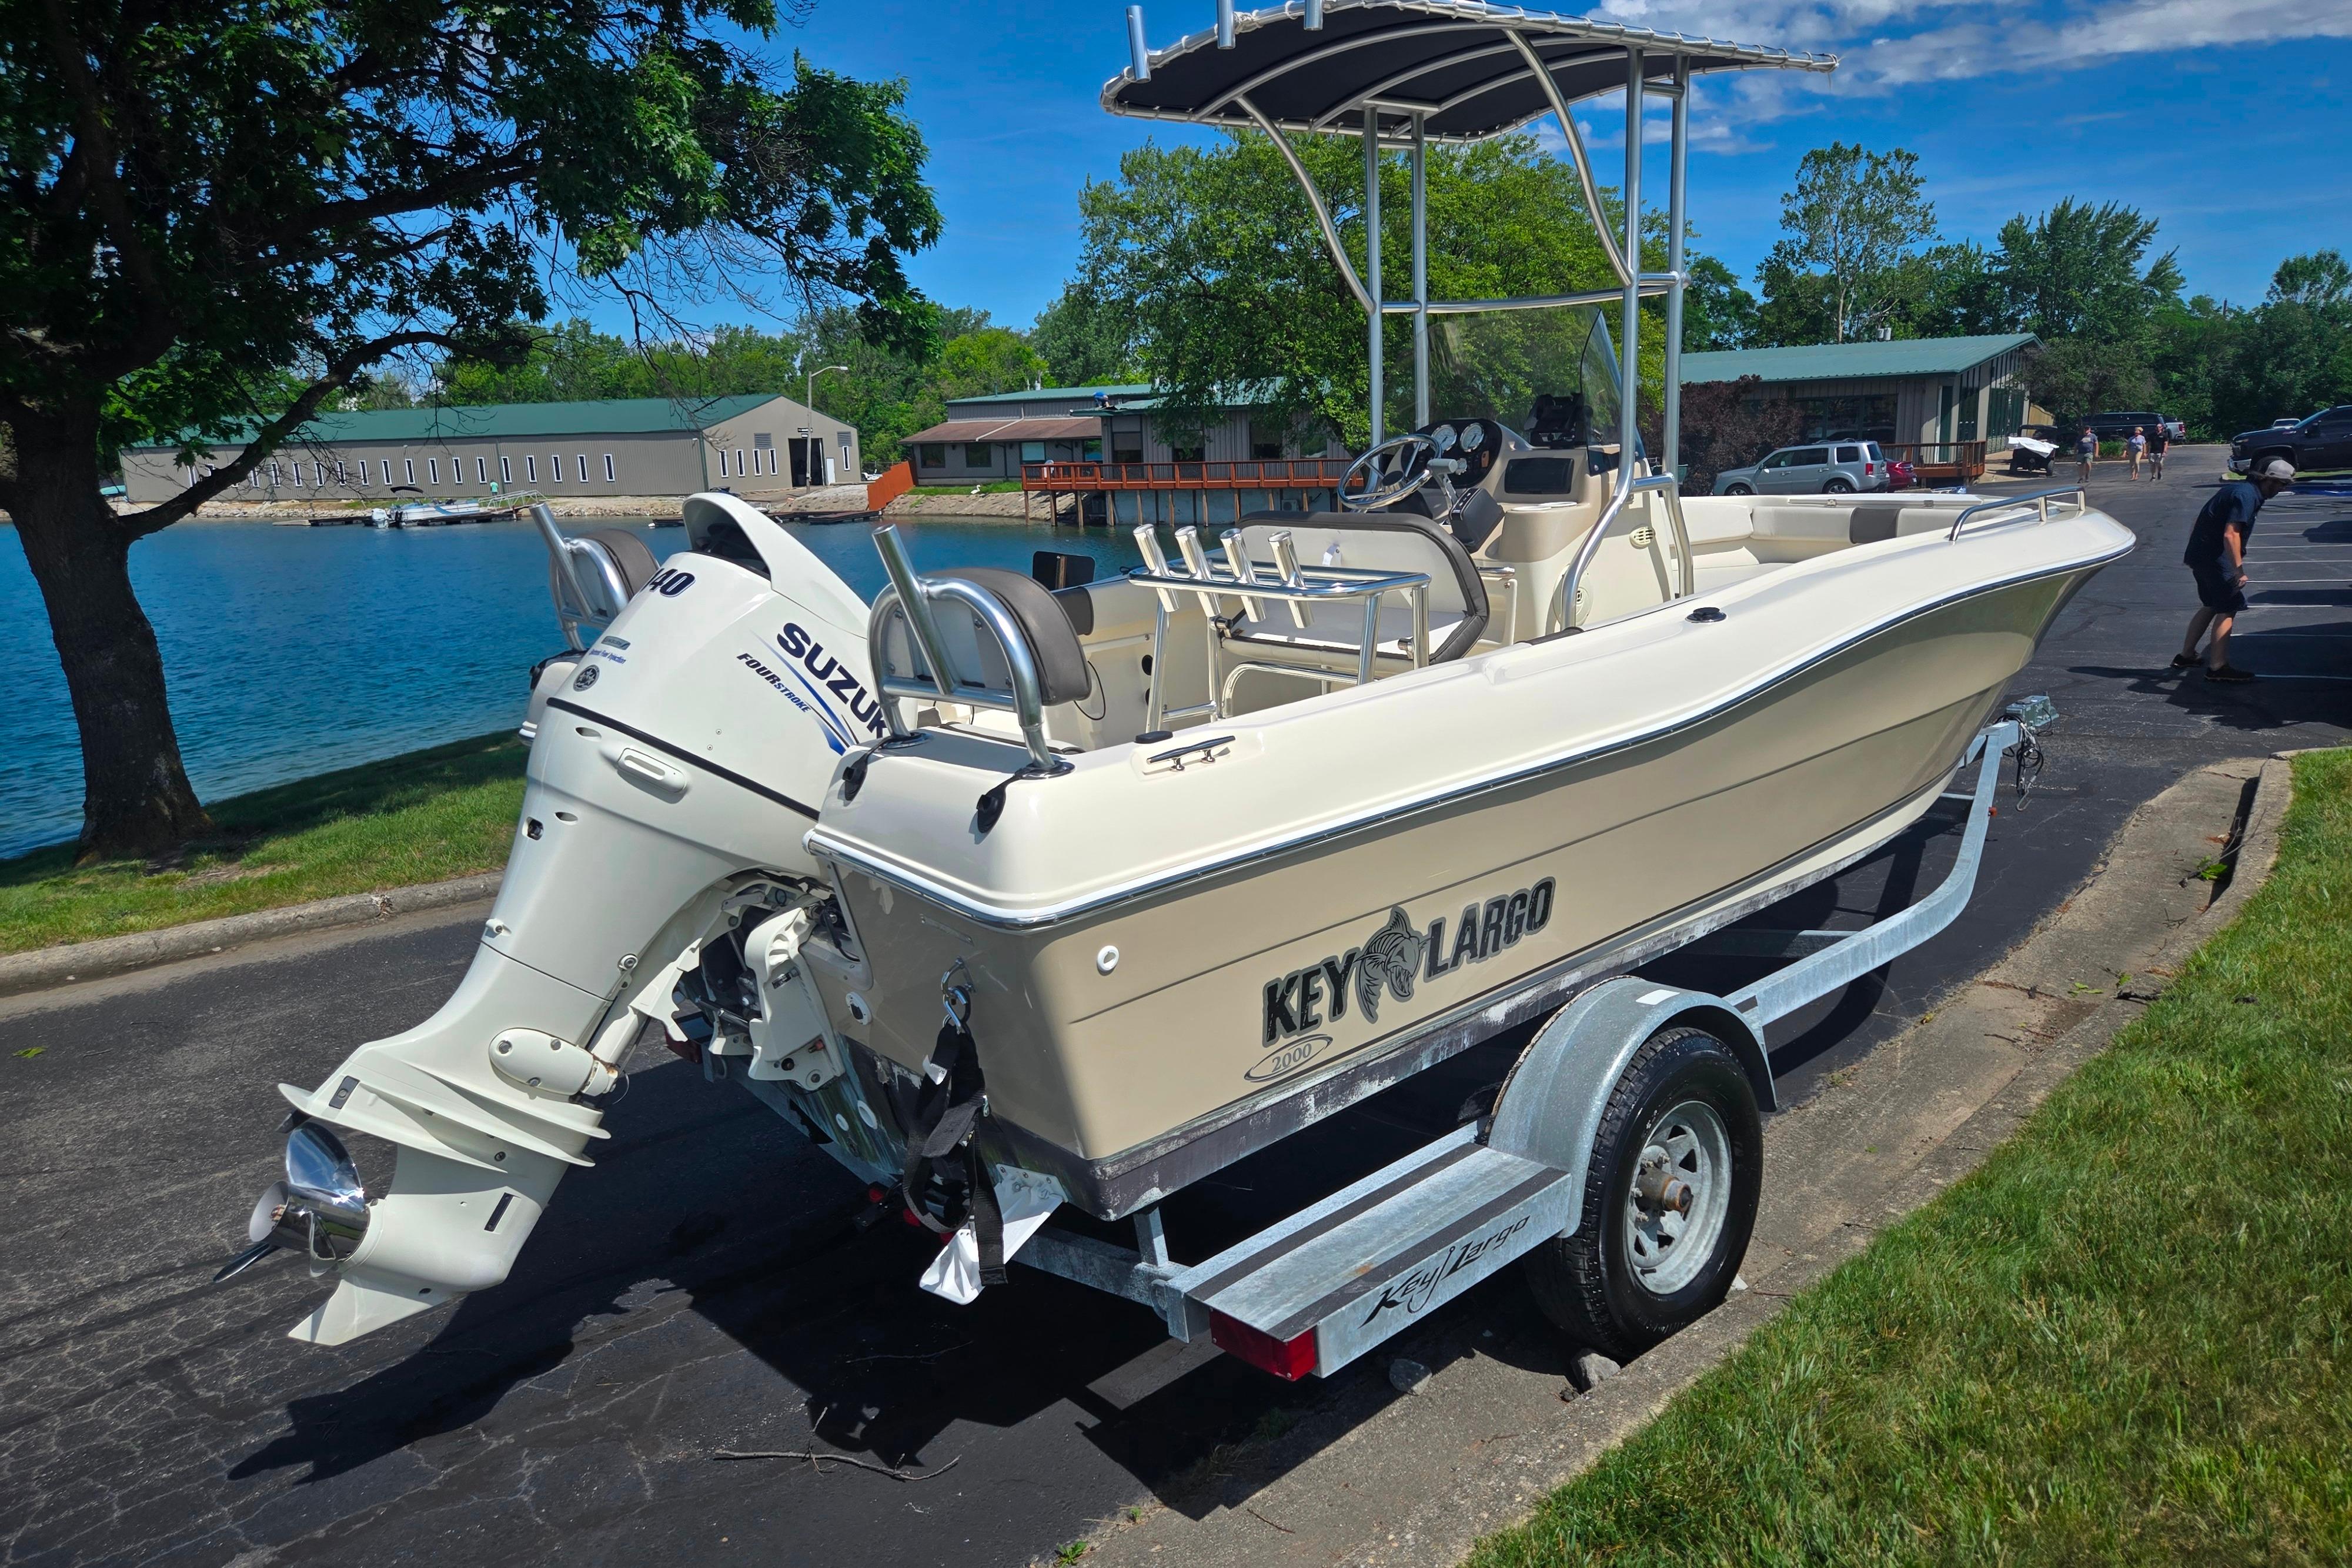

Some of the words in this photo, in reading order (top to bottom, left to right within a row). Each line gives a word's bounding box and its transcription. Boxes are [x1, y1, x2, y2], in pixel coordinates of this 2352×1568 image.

[776, 623, 887, 739] SUZUK
[1265, 950, 1358, 1044] KEY
[1426, 879, 1554, 979] LARGO
[1271, 1043, 1312, 1073] 2000
[1357, 1266, 1440, 1329] Key
[1441, 1215, 1530, 1281] Largo
